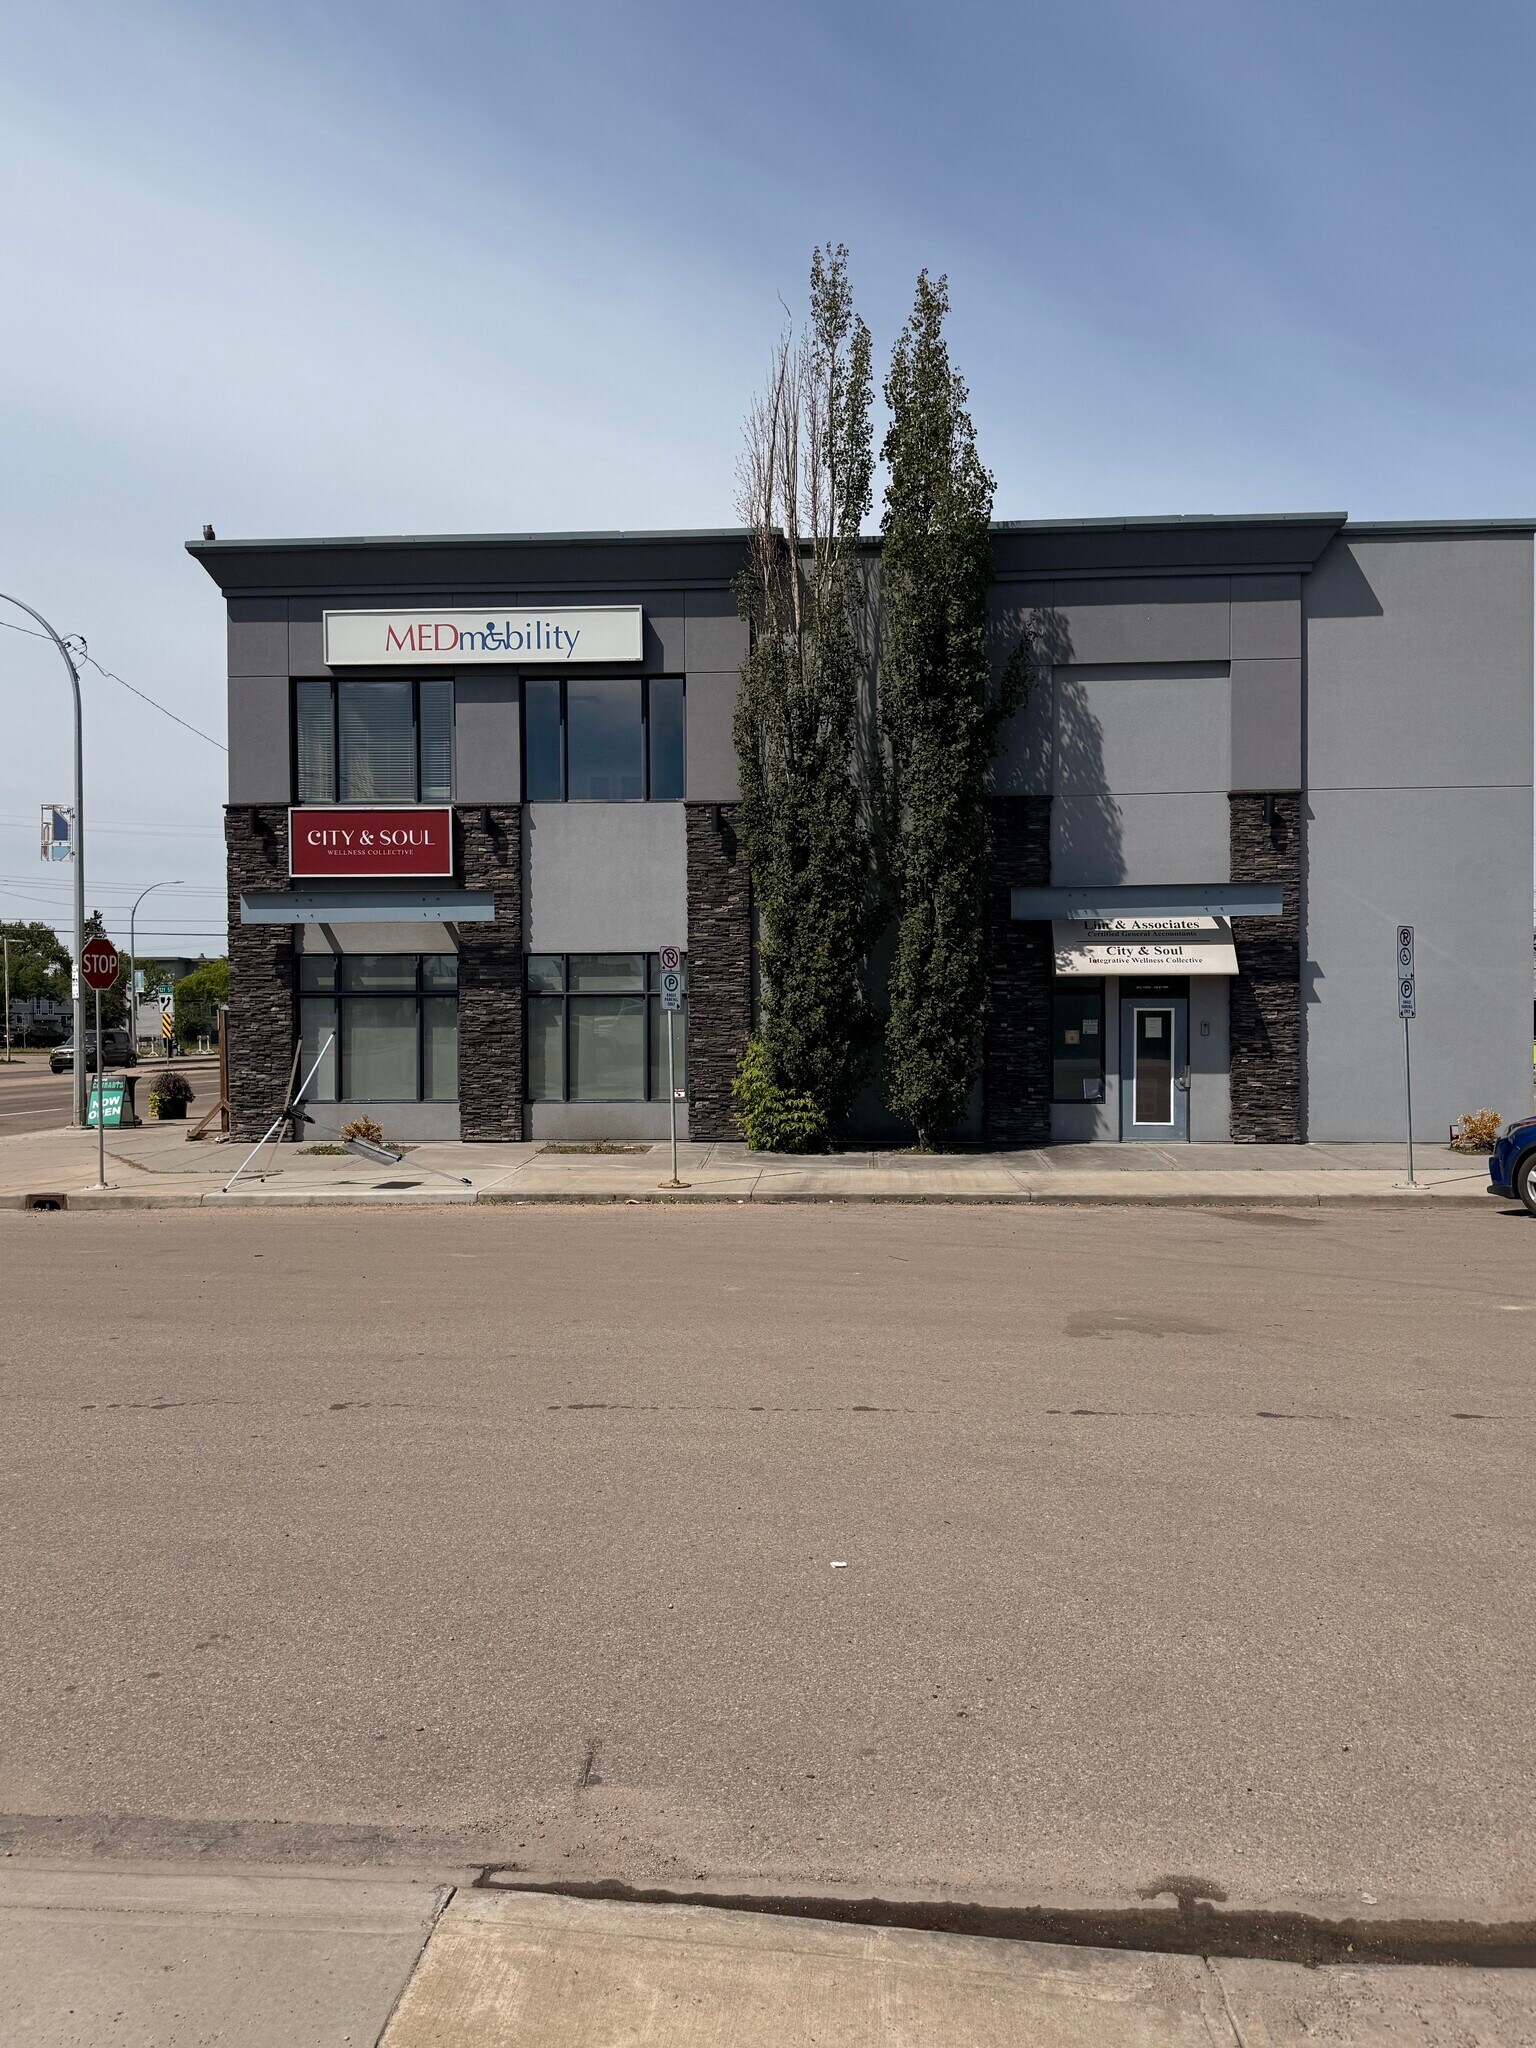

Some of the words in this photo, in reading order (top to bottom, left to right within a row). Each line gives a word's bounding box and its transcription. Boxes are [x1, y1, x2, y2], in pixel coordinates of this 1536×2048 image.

[307, 829, 355, 846] CITY
[359, 829, 374, 846] &
[379, 829, 436, 846] SOUL
[1115, 919, 1126, 930] &
[1131, 919, 1200, 930] Associates
[1106, 945, 1134, 957] City
[1138, 945, 1150, 956] &
[1154, 945, 1183, 956] Soul
[83, 953, 117, 974] STOP
[1089, 957, 1130, 965] Integrative
[92, 1096, 120, 1109] NOW
[89, 1106, 121, 1119] OEN
